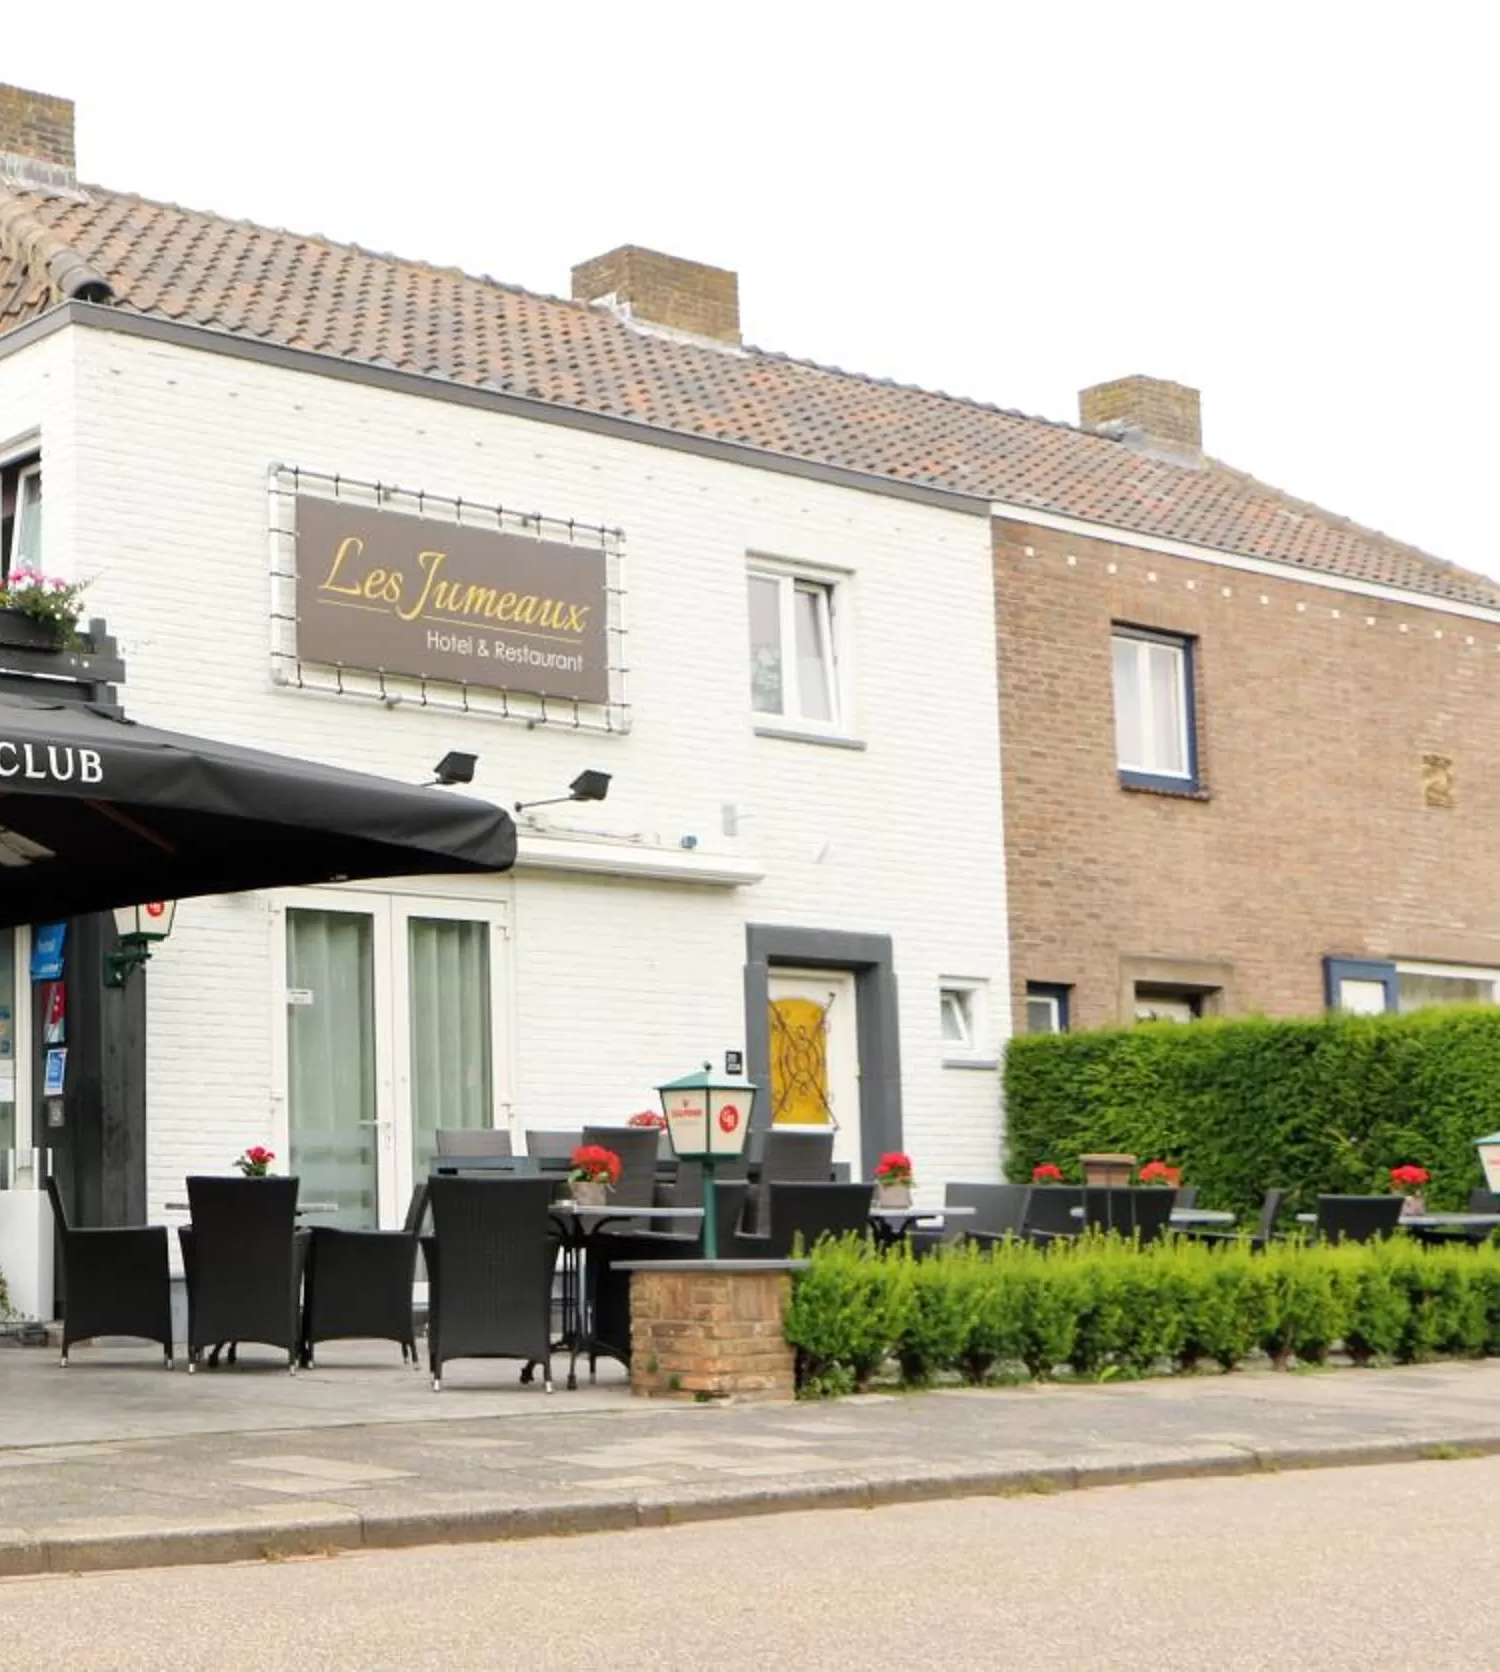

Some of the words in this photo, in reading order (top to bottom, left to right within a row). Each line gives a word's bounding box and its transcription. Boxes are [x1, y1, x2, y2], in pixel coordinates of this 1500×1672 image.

[318, 537, 404, 603] Les
[396, 551, 590, 633] Jumeaux
[427, 629, 473, 656] Hotel
[477, 640, 490, 657] &
[494, 640, 584, 673] Restaurant
